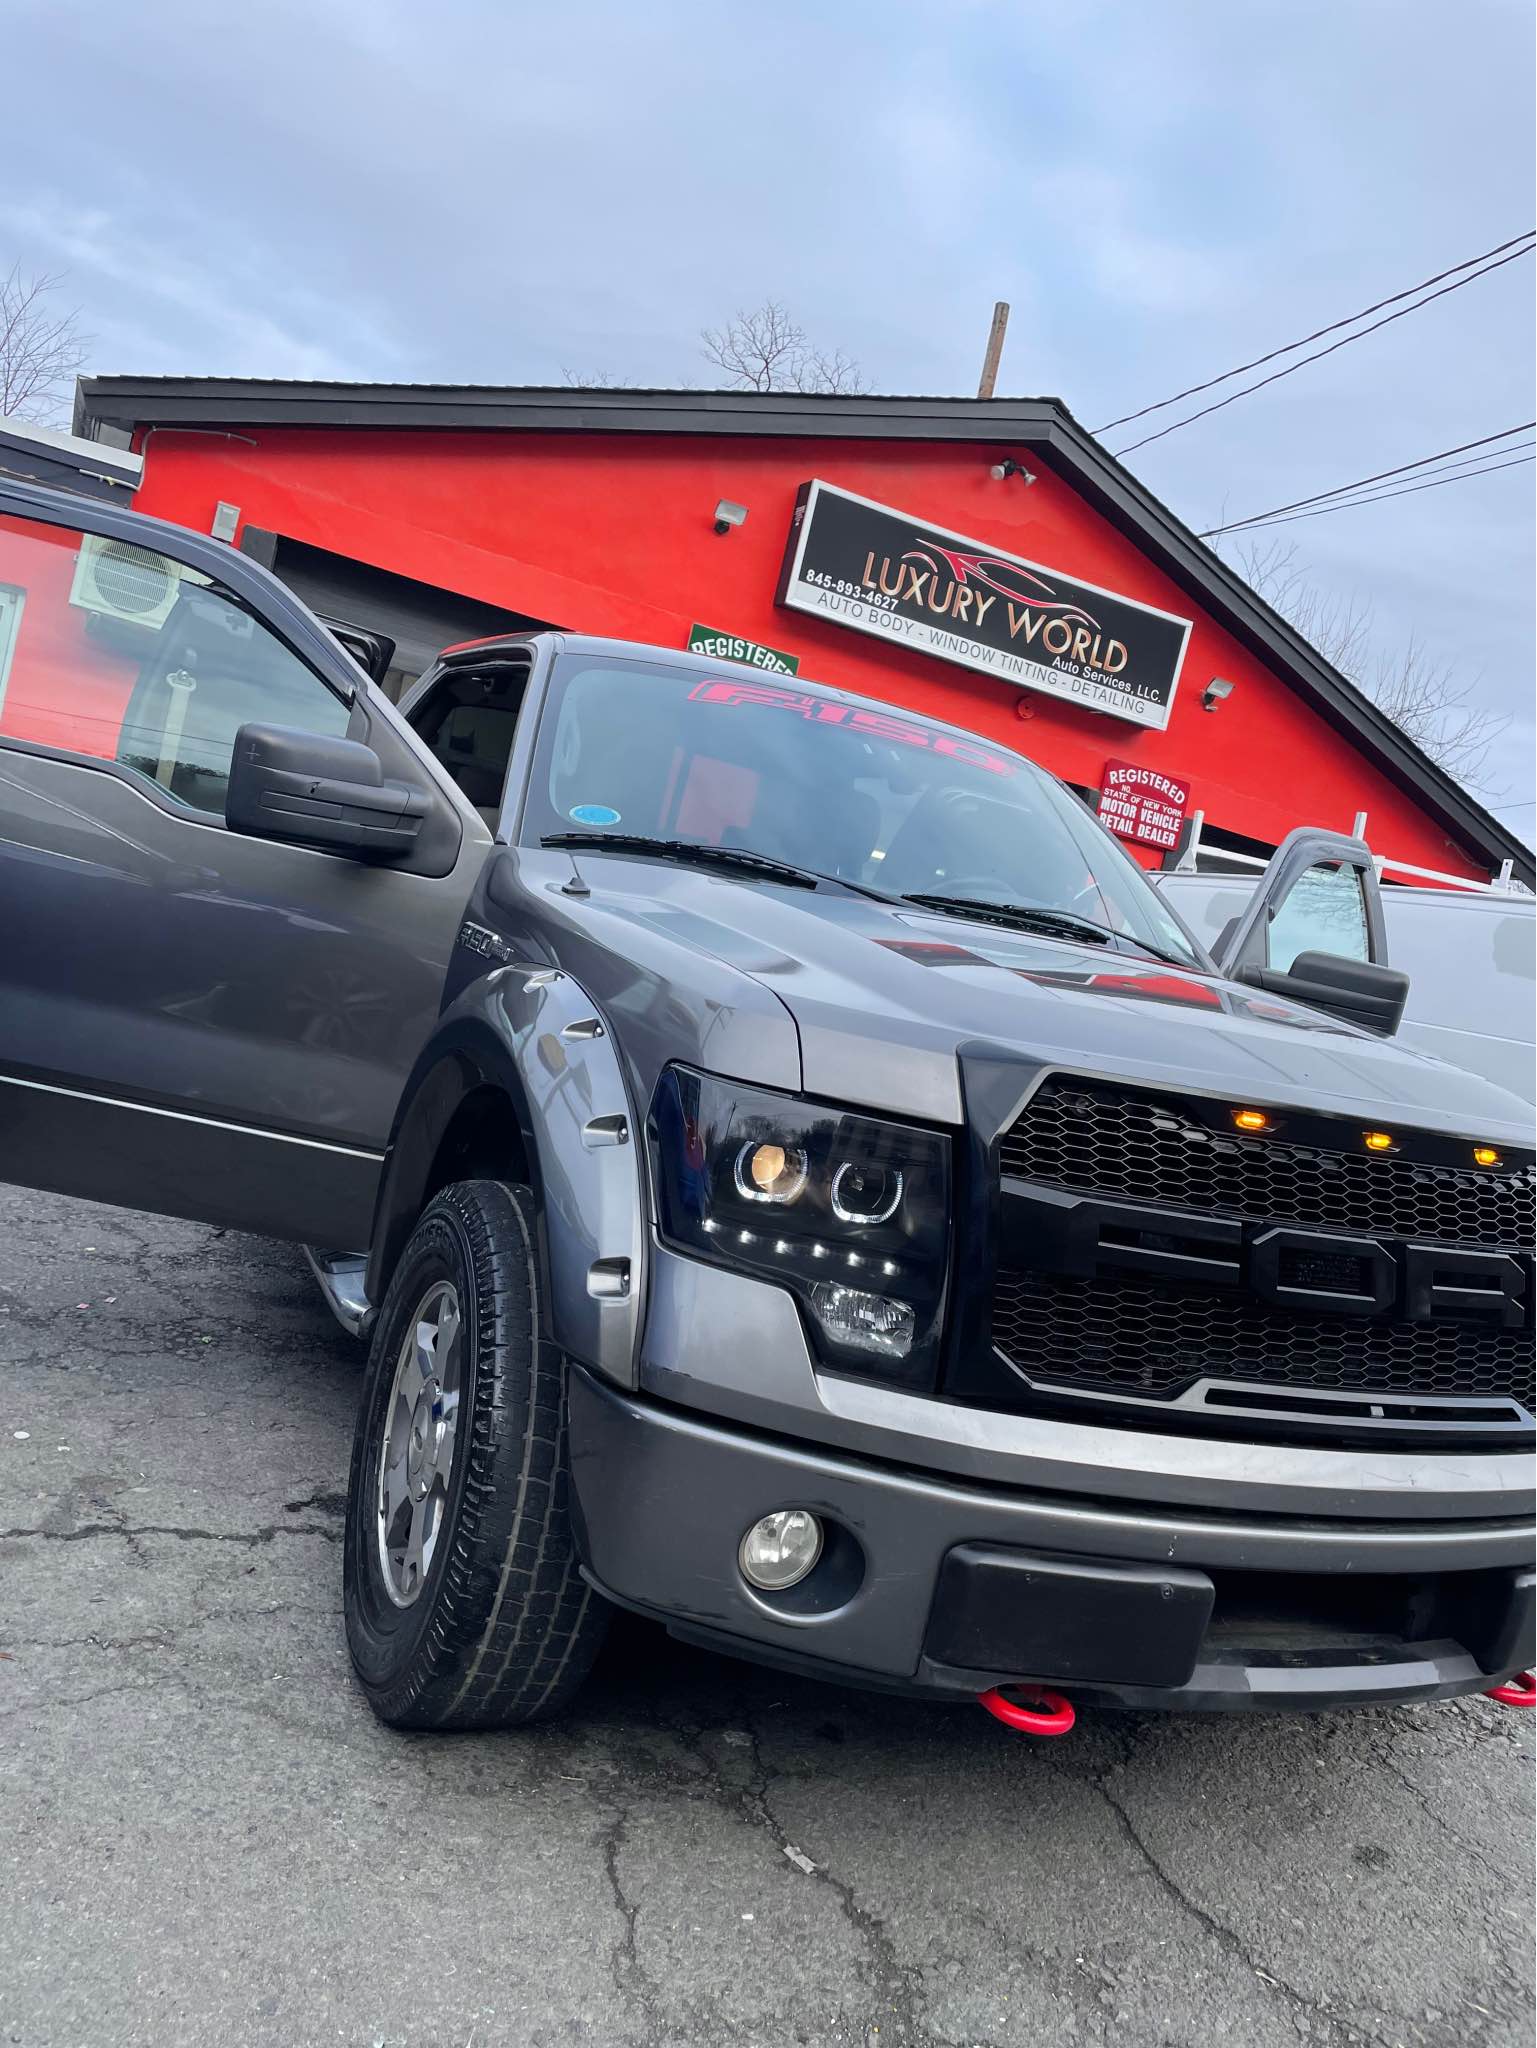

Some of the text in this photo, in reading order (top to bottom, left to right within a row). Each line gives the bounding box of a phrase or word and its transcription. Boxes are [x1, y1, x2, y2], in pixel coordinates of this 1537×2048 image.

[806, 569, 899, 611] 845-893-4627
[862, 552, 1128, 673] LUXURY WORLD
[817, 592, 863, 617] AUTO
[868, 610, 914, 636] BODY
[929, 630, 996, 663] WINDOW
[1000, 654, 1058, 685] TINTING
[1071, 679, 1145, 713] DETAILING
[1052, 656, 1161, 702] Auto Services, LLC.
[1104, 787, 1183, 818] STATE OF NEW YORK
[1109, 769, 1186, 804] REGISTERED
[1100, 796, 1182, 832] MOTOR VEHICLE
[1100, 812, 1176, 847] RETAIL DEALER
[1066, 1199, 1536, 1328] FOR
